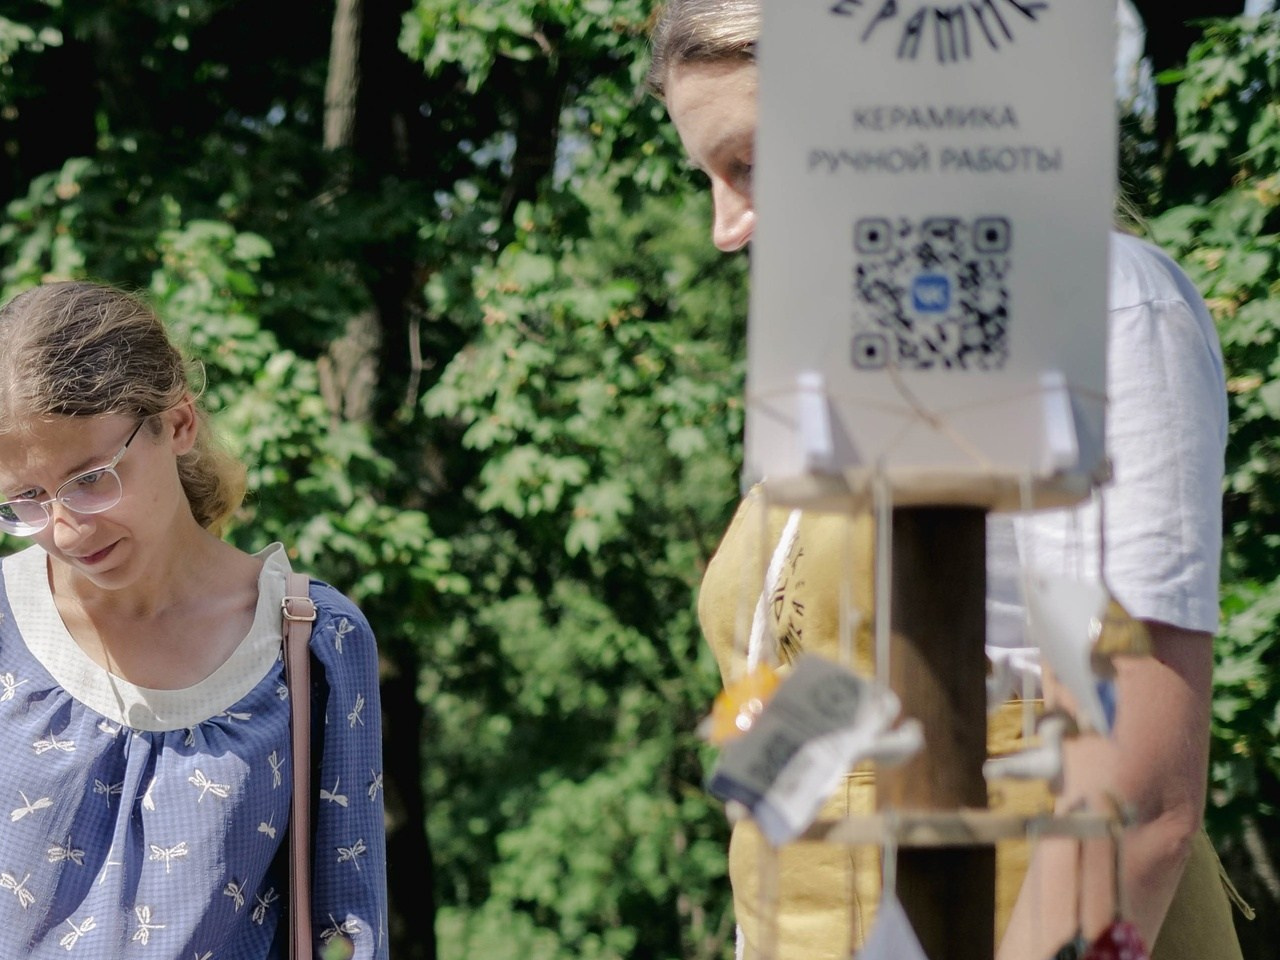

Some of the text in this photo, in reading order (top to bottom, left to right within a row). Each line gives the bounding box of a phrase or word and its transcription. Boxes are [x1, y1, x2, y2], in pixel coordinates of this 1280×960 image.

[853, 106, 1018, 131] КЕРАМИКА
[808, 144, 1063, 172] РУЧНОЙ РАБОТЫ
